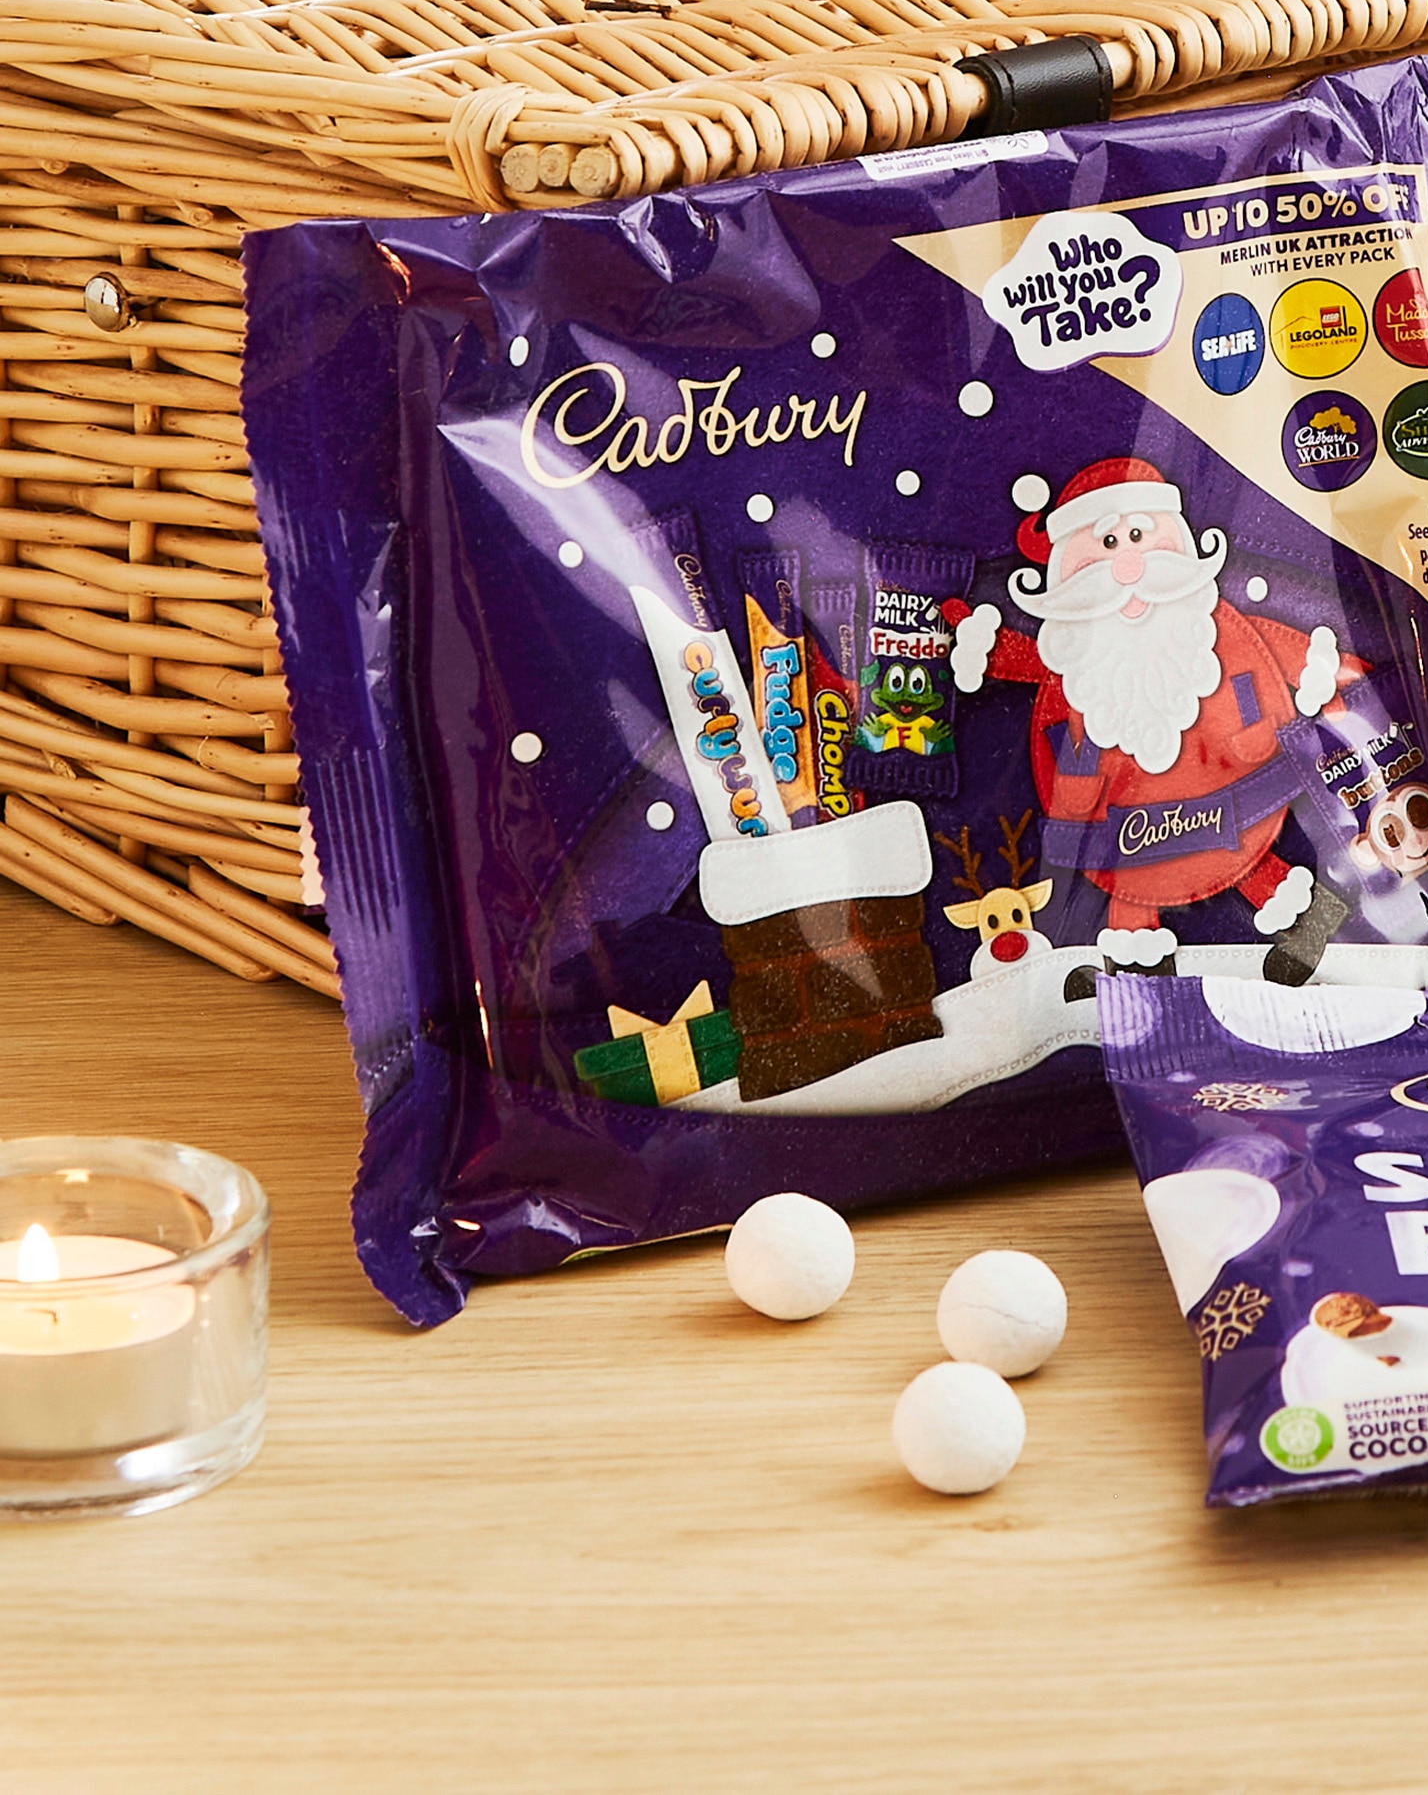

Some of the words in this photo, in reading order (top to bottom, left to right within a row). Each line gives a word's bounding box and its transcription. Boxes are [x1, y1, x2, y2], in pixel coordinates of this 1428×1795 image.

[1183, 207, 1228, 240] UP
[1276, 189, 1357, 223] 50%
[1049, 234, 1122, 272] Who
[1220, 242, 1271, 265] MERLIN
[1276, 237, 1300, 254] UK
[1305, 227, 1413, 251] ATTRACTION
[1251, 256, 1288, 276] WITH
[1293, 252, 1345, 271] EVERY
[1350, 246, 1395, 264] PACK
[1003, 273, 1057, 308] will
[1059, 266, 1116, 305] you
[1290, 326, 1357, 342] LEGOLAND
[520, 362, 867, 489] Cadbury
[1294, 426, 1347, 447] Cadbury
[1297, 441, 1360, 464] WORLD
[874, 608, 918, 627] MILK
[876, 591, 933, 611] DAIRY
[874, 632, 949, 658] Freddo
[760, 643, 803, 783] Fudge
[1321, 750, 1362, 784] DAIRY
[1119, 804, 1222, 856] Cadbury
